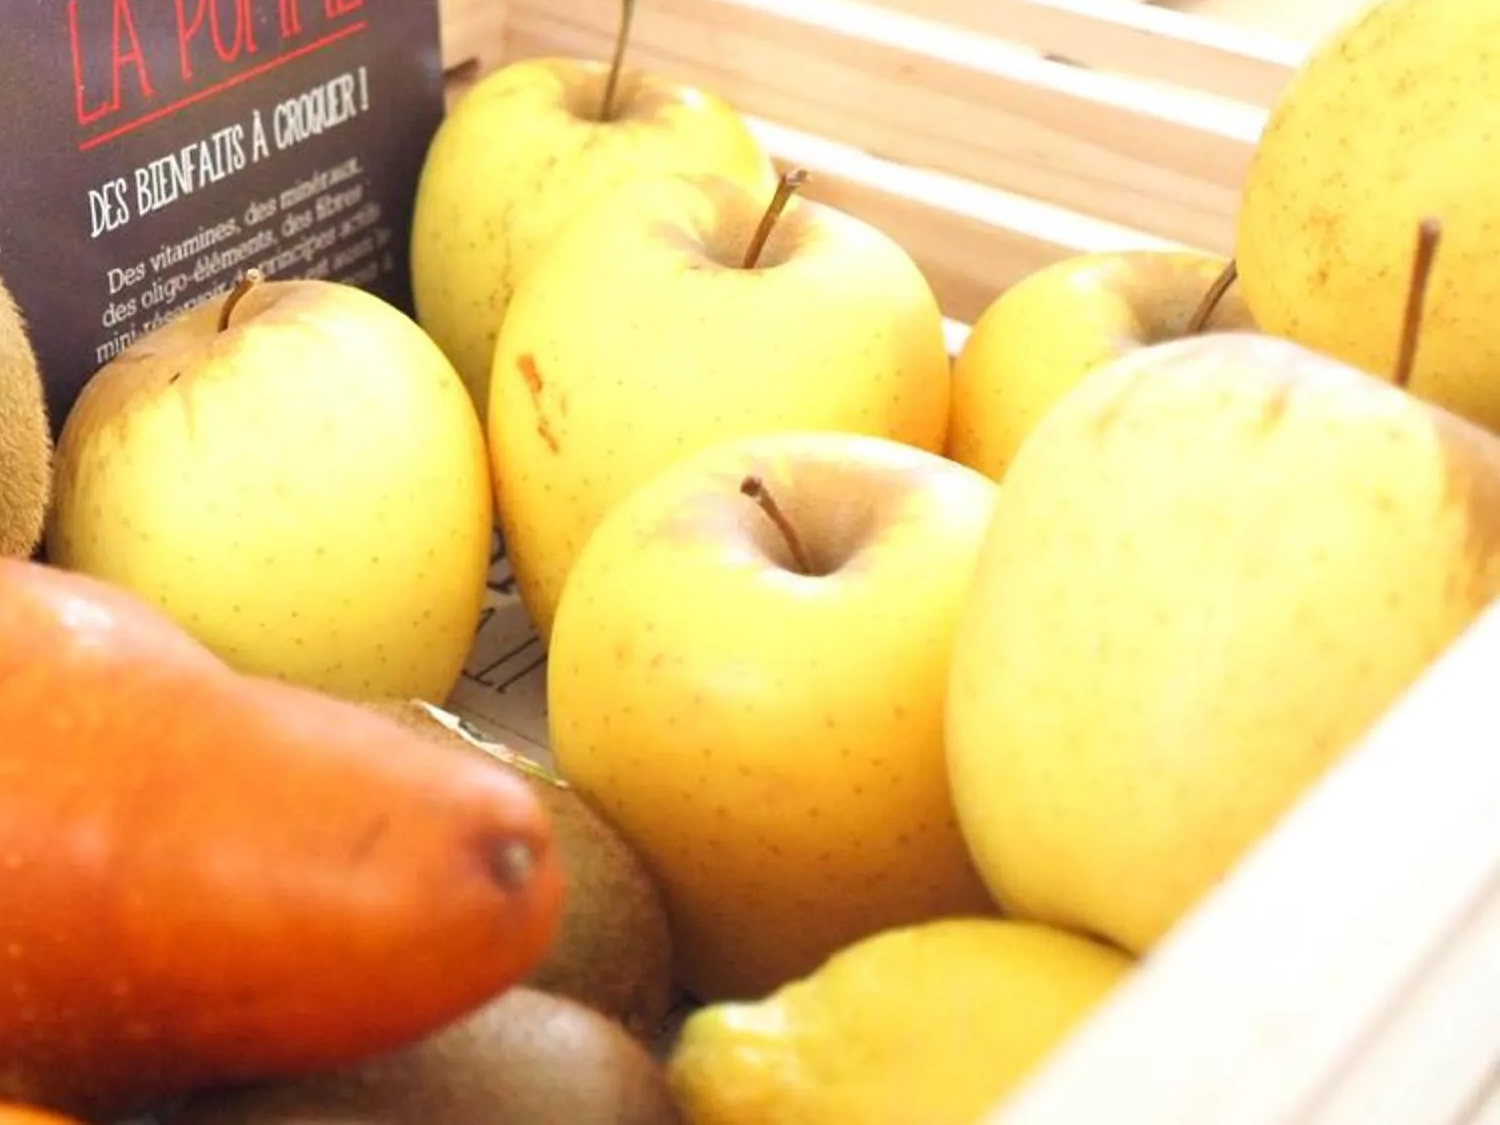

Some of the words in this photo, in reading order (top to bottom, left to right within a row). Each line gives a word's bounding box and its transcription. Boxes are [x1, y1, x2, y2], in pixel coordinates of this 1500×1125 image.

[88, 177, 130, 238] DES
[135, 124, 247, 216] BIENFAITS
[252, 110, 270, 163] À
[273, 72, 357, 150] CROQUER
[102, 299, 138, 328] des
[281, 209, 314, 237] des
[107, 260, 146, 295] Des
[149, 217, 242, 272] vitamines,
[244, 197, 277, 225] des
